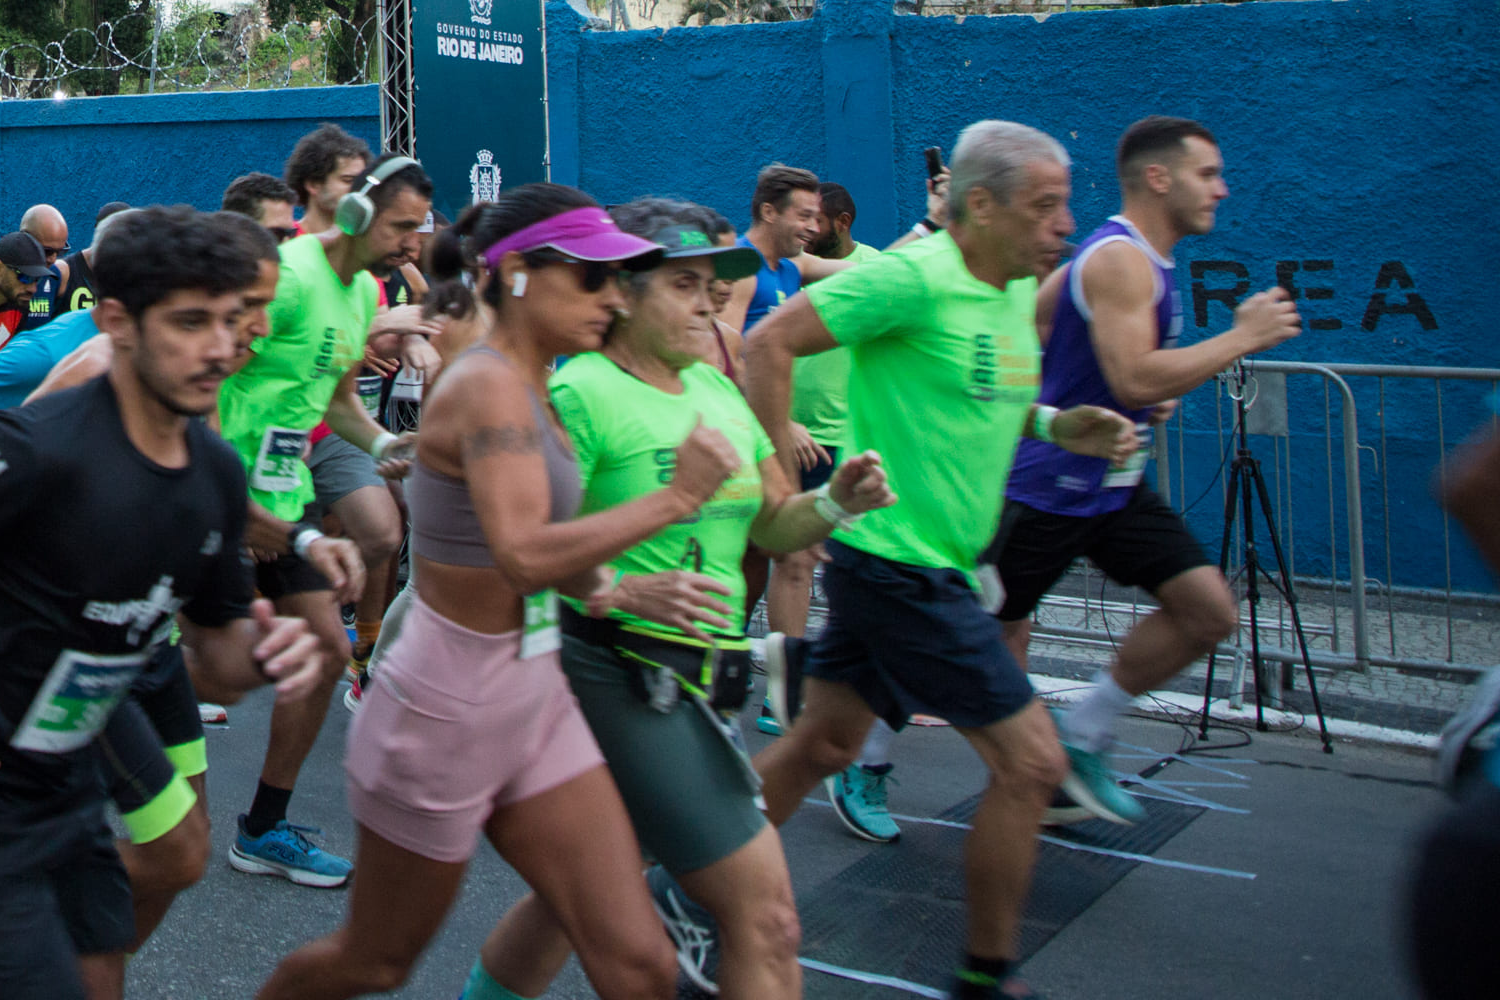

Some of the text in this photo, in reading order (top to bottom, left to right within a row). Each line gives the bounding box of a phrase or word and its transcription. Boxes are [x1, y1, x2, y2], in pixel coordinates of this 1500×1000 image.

[436, 22, 523, 44] GOVERNO DO ESTADO
[436, 36, 524, 65] RIO DE JANEIRO
